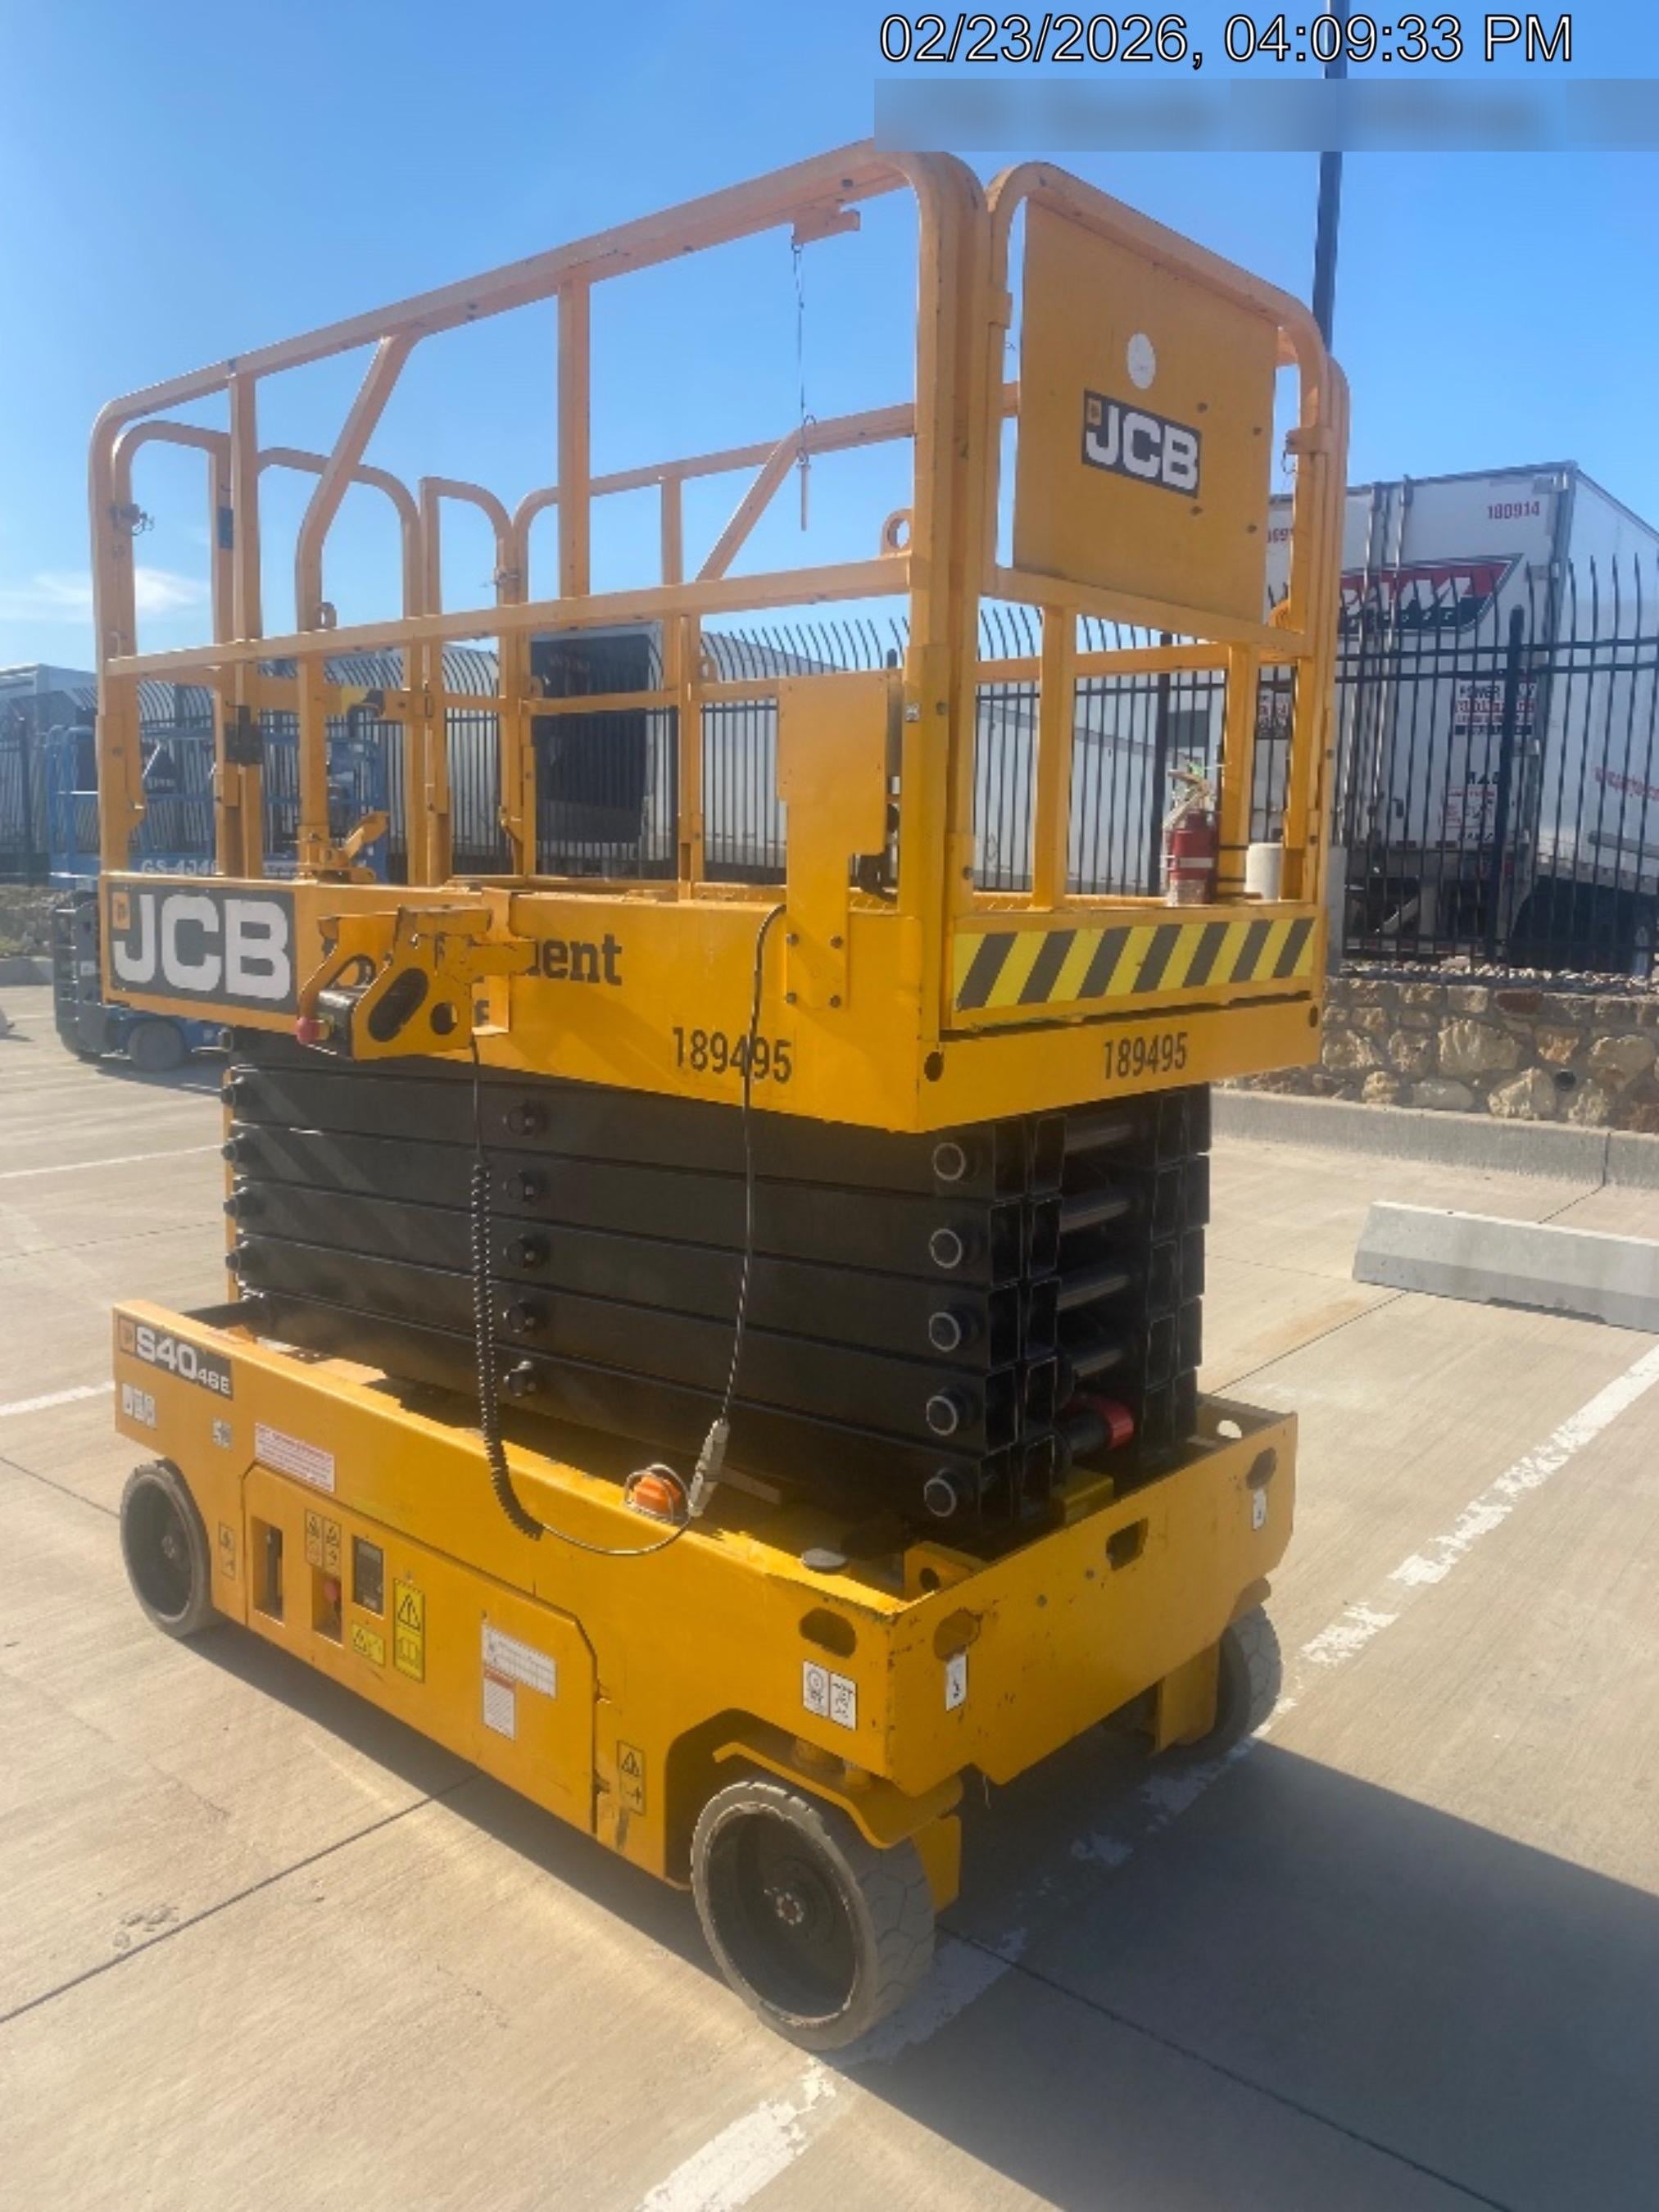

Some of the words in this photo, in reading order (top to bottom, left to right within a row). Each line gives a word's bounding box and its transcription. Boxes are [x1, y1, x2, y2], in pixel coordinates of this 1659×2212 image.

[1086, 405, 1199, 492] JCB
[112, 893, 291, 1001] JCB
[529, 934, 623, 986] ent
[673, 1027, 792, 1083] 189495
[1104, 1031, 1188, 1080] 189495
